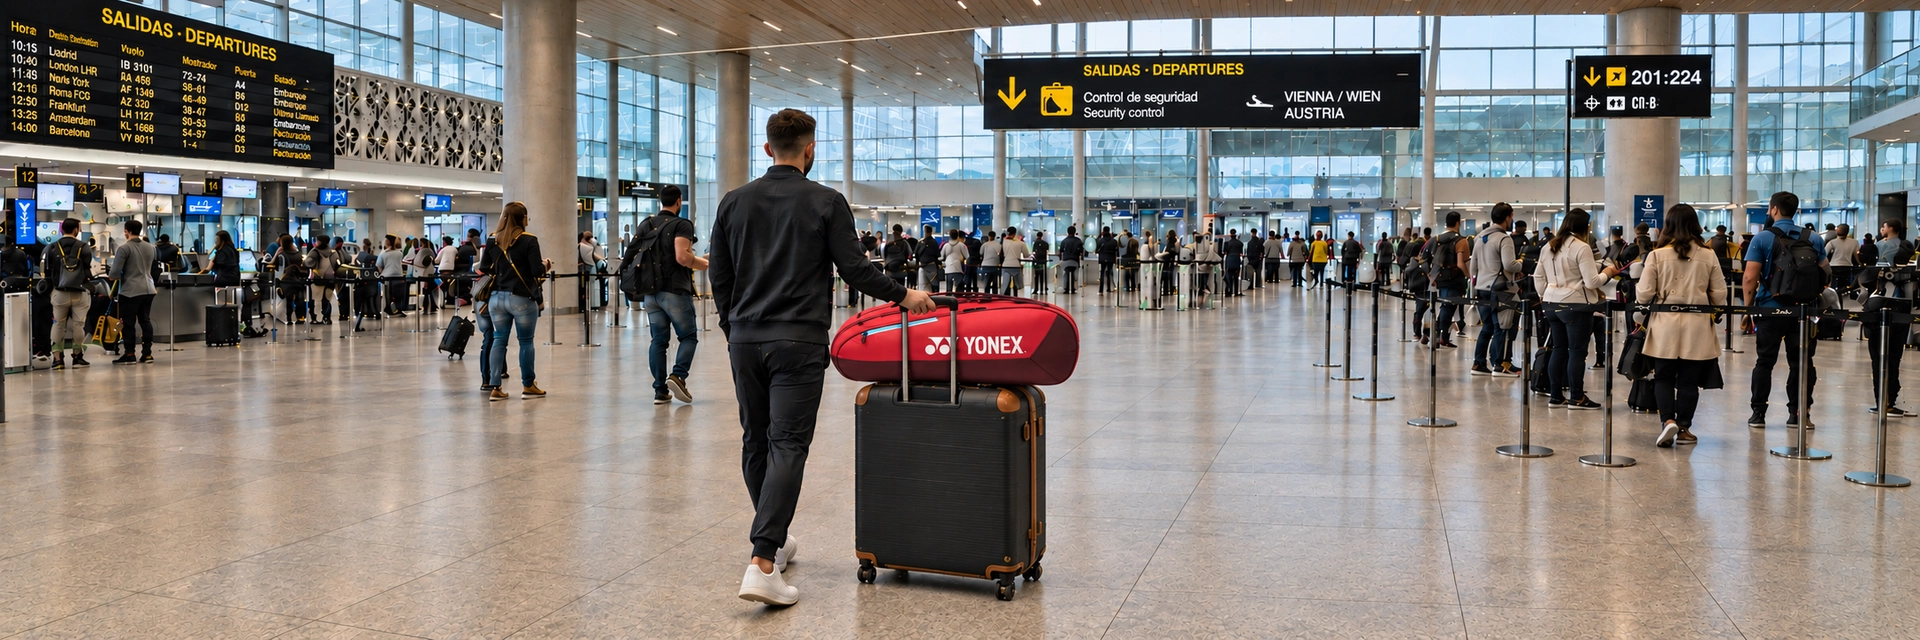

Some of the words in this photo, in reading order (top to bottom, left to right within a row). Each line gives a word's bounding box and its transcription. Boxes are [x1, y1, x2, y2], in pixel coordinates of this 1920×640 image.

[11, 20, 37, 36] Hora
[101, 7, 173, 38] SALIDAS
[185, 27, 277, 62] DEPARTURES
[49, 60, 79, 73] London
[81, 65, 98, 77] LHR
[120, 60, 130, 70] IB
[134, 62, 153, 74] 3101
[182, 70, 206, 83] 72-74
[235, 80, 246, 90] A4
[1083, 64, 1141, 77] SALIDAS
[1152, 63, 1244, 76] DEPARTURES
[1631, 69, 1702, 86] 201:224
[49, 86, 72, 98] Roma
[135, 99, 150, 109] 320
[72, 77, 90, 88] York
[120, 84, 132, 94] AF
[135, 87, 154, 98] 1349
[235, 102, 249, 112] D12
[1083, 91, 1124, 103] Control
[1127, 91, 1141, 103] de
[1144, 91, 1198, 105] seguridad
[1284, 91, 1334, 102] VIENNA
[1346, 90, 1381, 102] WIEN
[49, 112, 96, 126] Amsterdam
[120, 121, 132, 130] KL
[120, 109, 132, 119] LH
[134, 111, 154, 121] 1127
[1083, 107, 1126, 120] Security
[1128, 107, 1165, 118] control
[1284, 107, 1345, 119] AUSTRIA
[12, 121, 38, 133] 14:00
[120, 133, 132, 142] VY
[134, 135, 154, 144] 8011
[183, 140, 197, 148] 1-4
[235, 144, 246, 154] D3
[22, 171, 35, 183] 12
[964, 336, 1024, 354] YONEX
